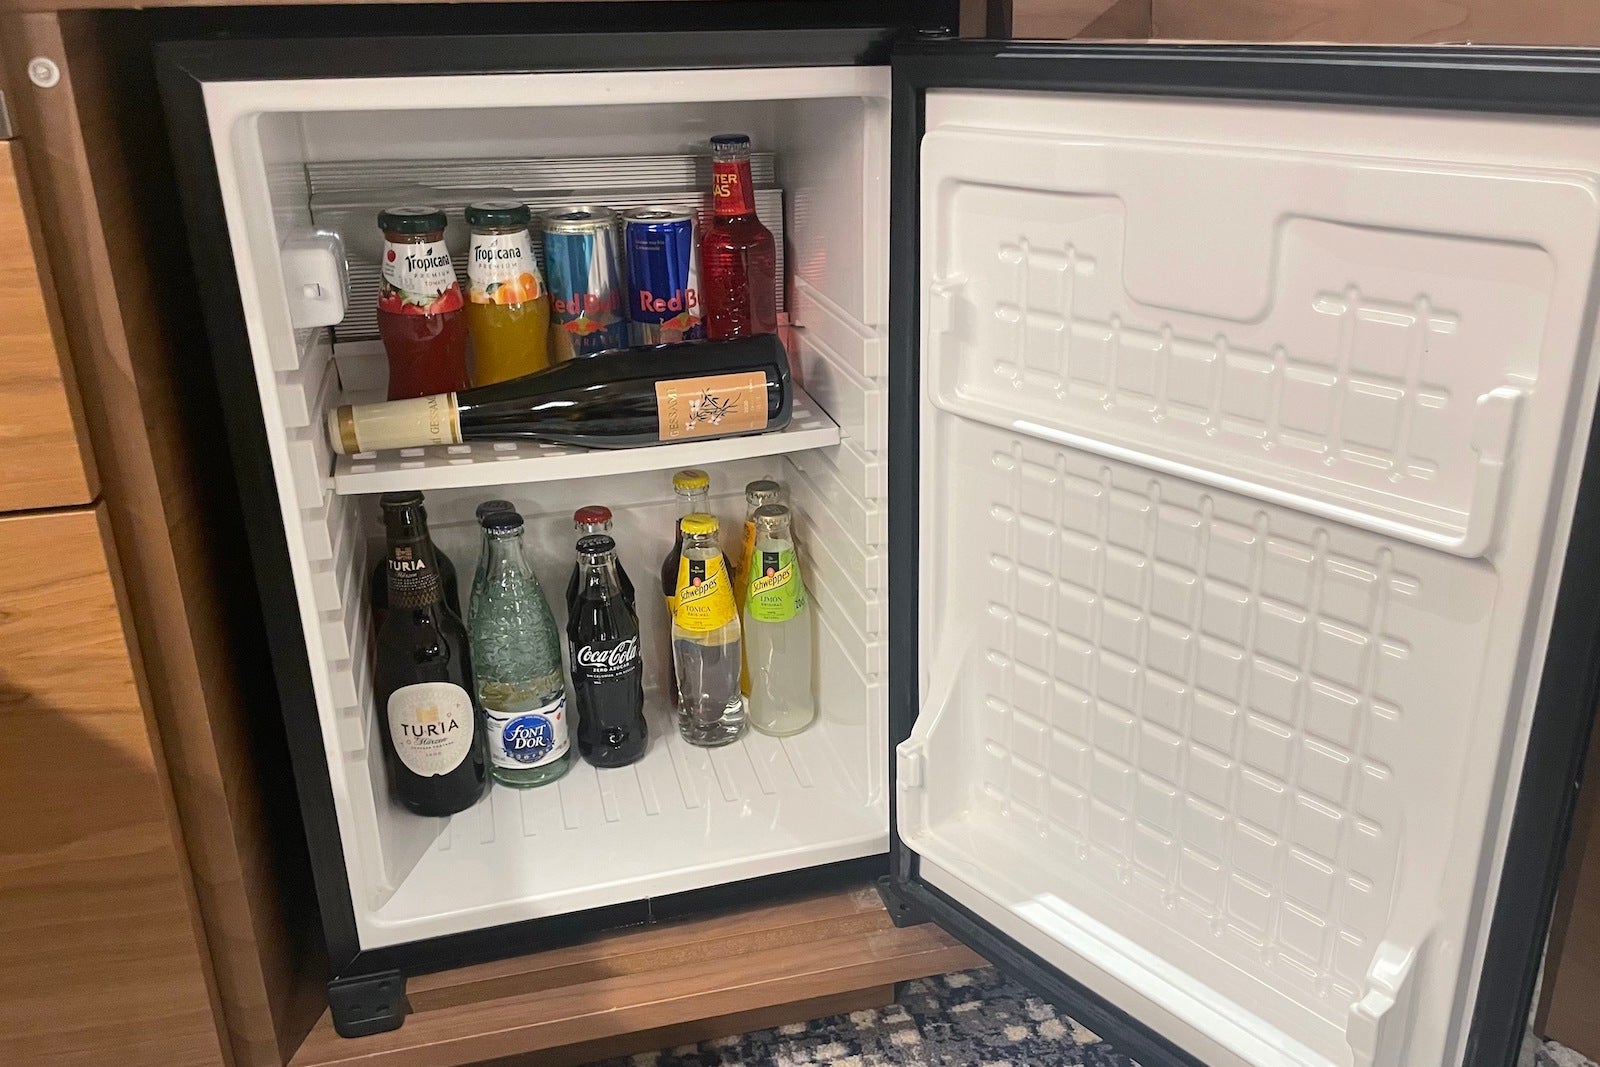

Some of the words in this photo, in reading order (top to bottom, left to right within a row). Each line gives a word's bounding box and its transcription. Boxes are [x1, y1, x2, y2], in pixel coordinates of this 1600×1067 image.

[405, 254, 450, 272] Tropicana
[474, 245, 521, 262] Tropicana
[414, 270, 450, 278] PREMIUM
[550, 292, 580, 314] ed
[640, 289, 682, 312] Red
[388, 558, 425, 571] TURIA
[680, 579, 717, 600] Schweppes
[753, 569, 790, 593] Schweppes
[577, 636, 637, 668] Coca-Cola
[401, 719, 459, 737] TURIA
